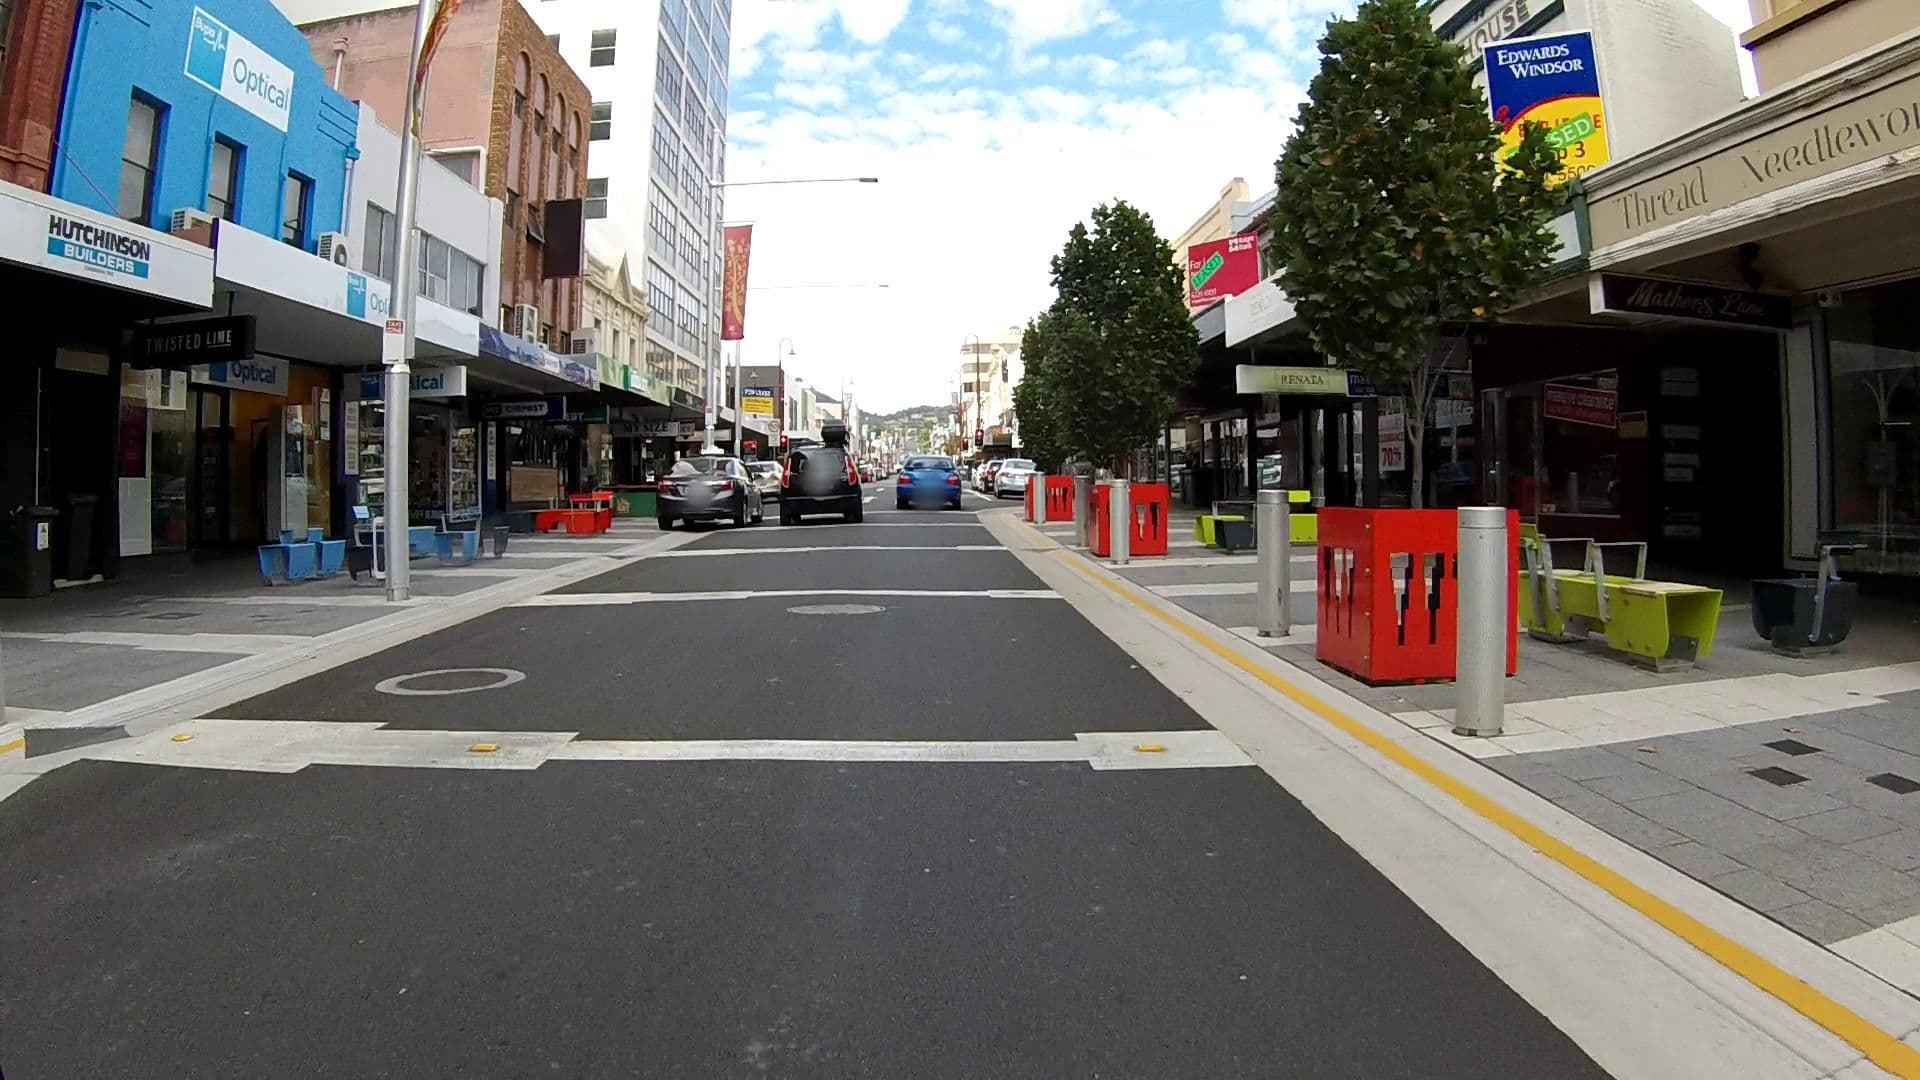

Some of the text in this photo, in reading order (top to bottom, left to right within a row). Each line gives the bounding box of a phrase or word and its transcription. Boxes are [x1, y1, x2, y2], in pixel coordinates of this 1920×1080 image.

[1465, 1, 1531, 60] HOUSE
[1497, 44, 1570, 66] EDWARDS
[1509, 58, 1584, 79] WINDSOR
[233, 58, 288, 111] Optical
[1616, 166, 1708, 229] Thread
[49, 214, 150, 261] HUTCHINSON
[64, 243, 134, 273] BUILDERS
[144, 330, 232, 353] TWISTED LIME
[232, 360, 276, 384] Optical
